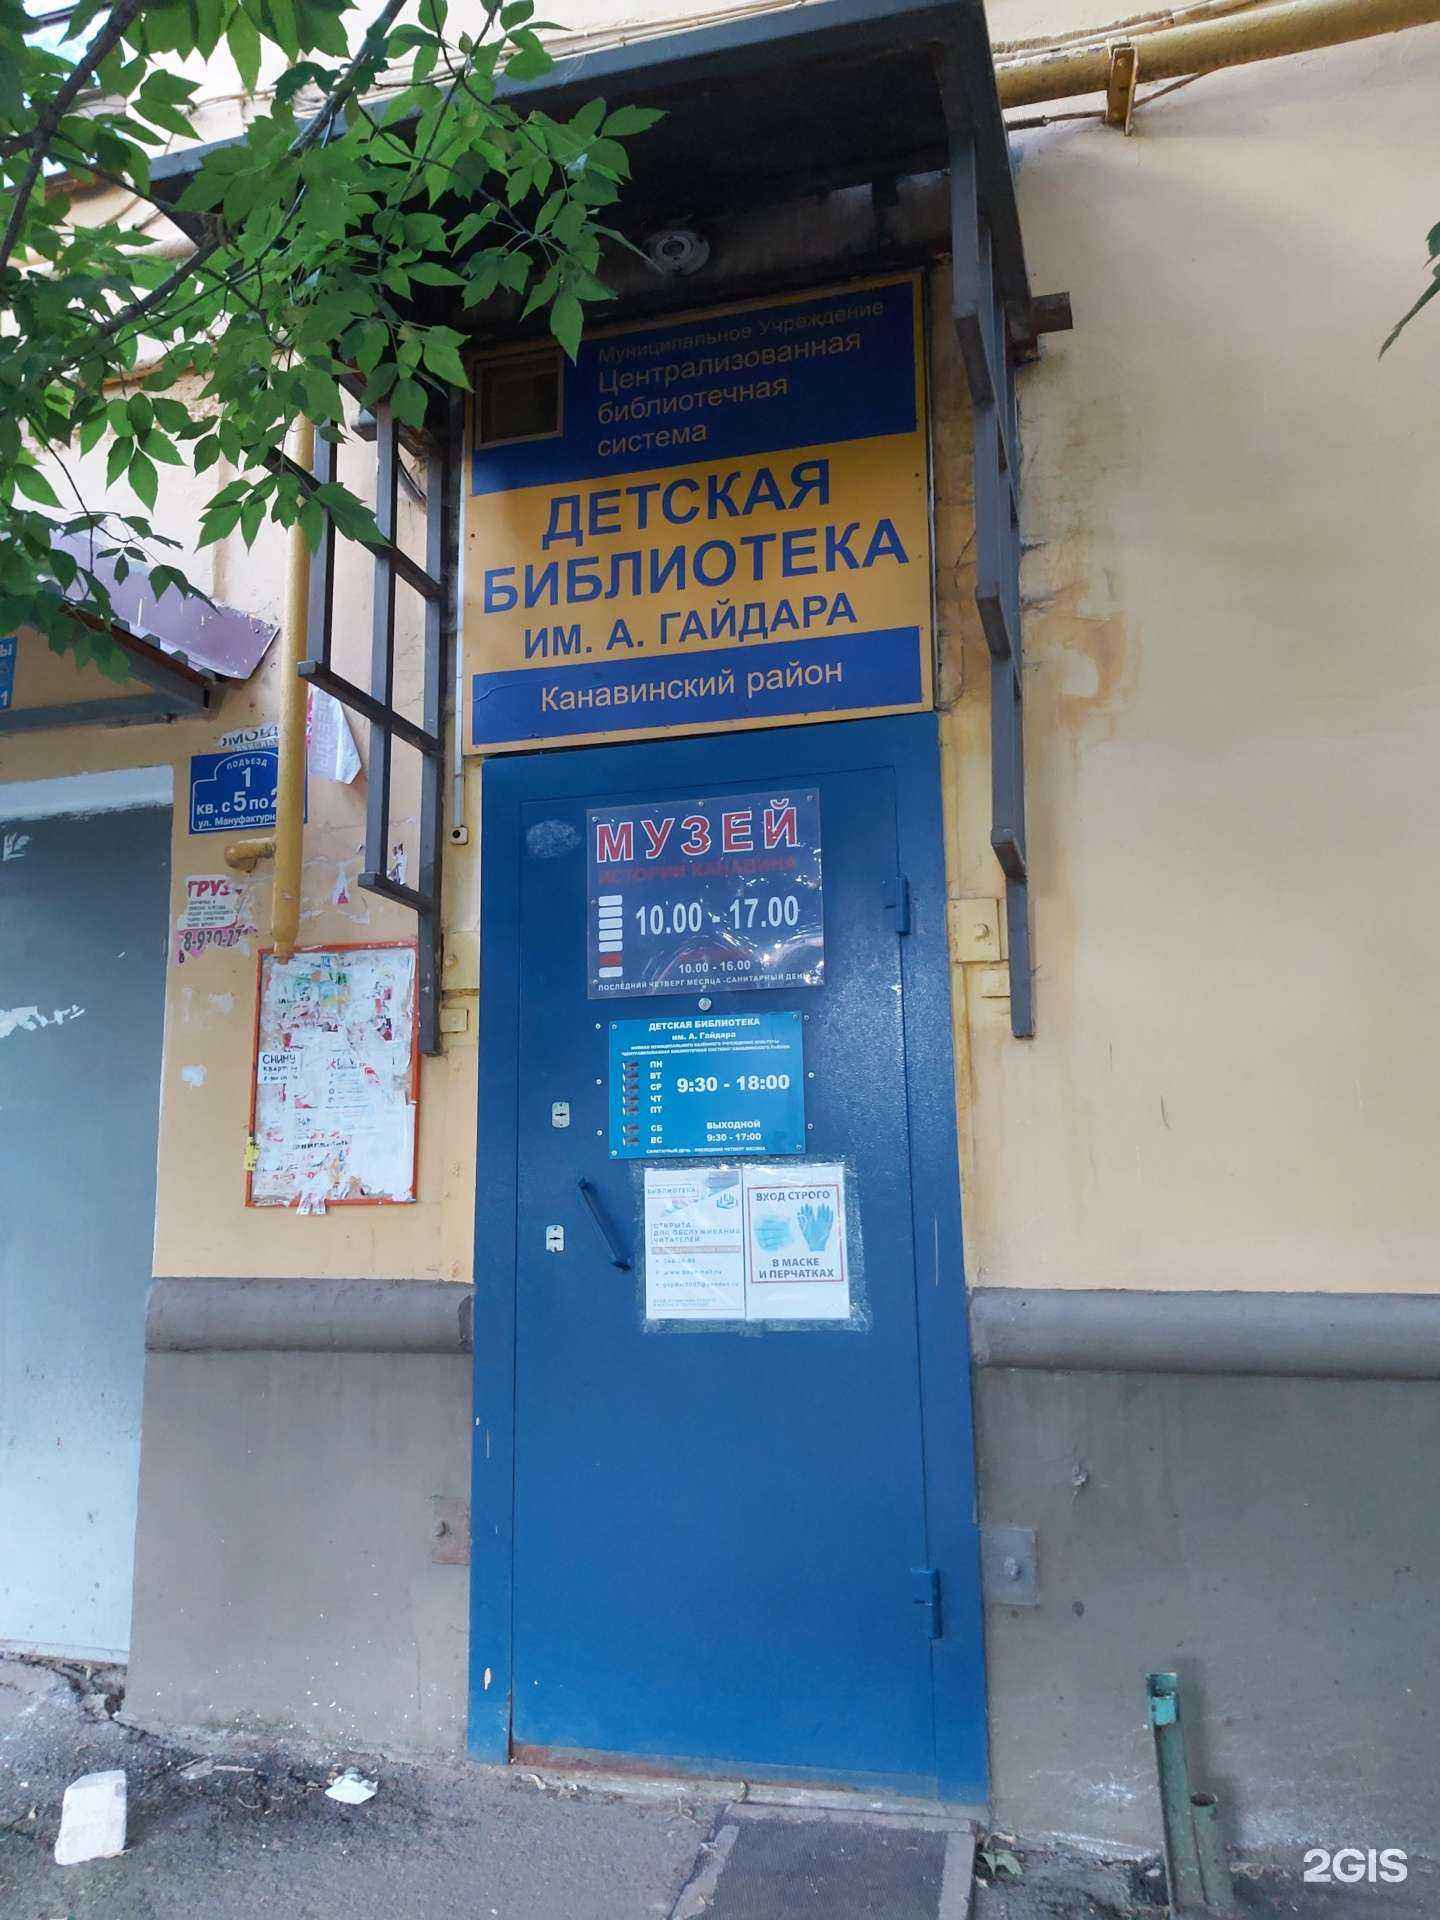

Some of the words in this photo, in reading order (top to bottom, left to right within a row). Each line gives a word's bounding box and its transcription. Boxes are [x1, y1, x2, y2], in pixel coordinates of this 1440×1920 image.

[599, 323, 752, 363] Муниципальное
[759, 301, 884, 337] Учреждение
[599, 331, 862, 395] Централизованная
[598, 377, 789, 425] библиотечная
[597, 424, 707, 458] система
[541, 458, 830, 551] ДЕТСКАЯ
[484, 518, 909, 614] БИБЛИОТЕКА
[525, 624, 592, 659] ИМ.
[606, 619, 644, 650] А.
[660, 592, 857, 644] ГАЙДАРА
[541, 670, 735, 712] Канавинский
[747, 660, 843, 698] район
[242, 767, 251, 788] 1
[234, 791, 247, 812] 5
[250, 798, 269, 810] по
[198, 819, 212, 829] ул.
[597, 798, 798, 863] МУЗЕЙ
[636, 902, 702, 936] 10.00
[730, 895, 799, 929] 17.00
[678, 962, 709, 974] 10.00
[720, 960, 751, 972] 16.00
[648, 1021, 692, 1031] ДЕТСКАЯ
[695, 1017, 760, 1028] БИБЛИОТЕКА
[700, 1031, 736, 1040] Гайдара
[676, 1077, 718, 1093] 9:30
[736, 1074, 790, 1091] 18:00
[706, 1120, 761, 1130] ВЫХОДНОЙ
[706, 1134, 727, 1142] 9:30
[735, 1132, 761, 1141] 17:00
[756, 1191, 786, 1202] ВХОД
[788, 1190, 831, 1200] СТРОГО
[772, 1259, 779, 1267] В
[782, 1257, 820, 1267] МАСКЕ
[759, 1271, 767, 1279] И
[769, 1268, 835, 1279] ПЕРЧАТКАХ
